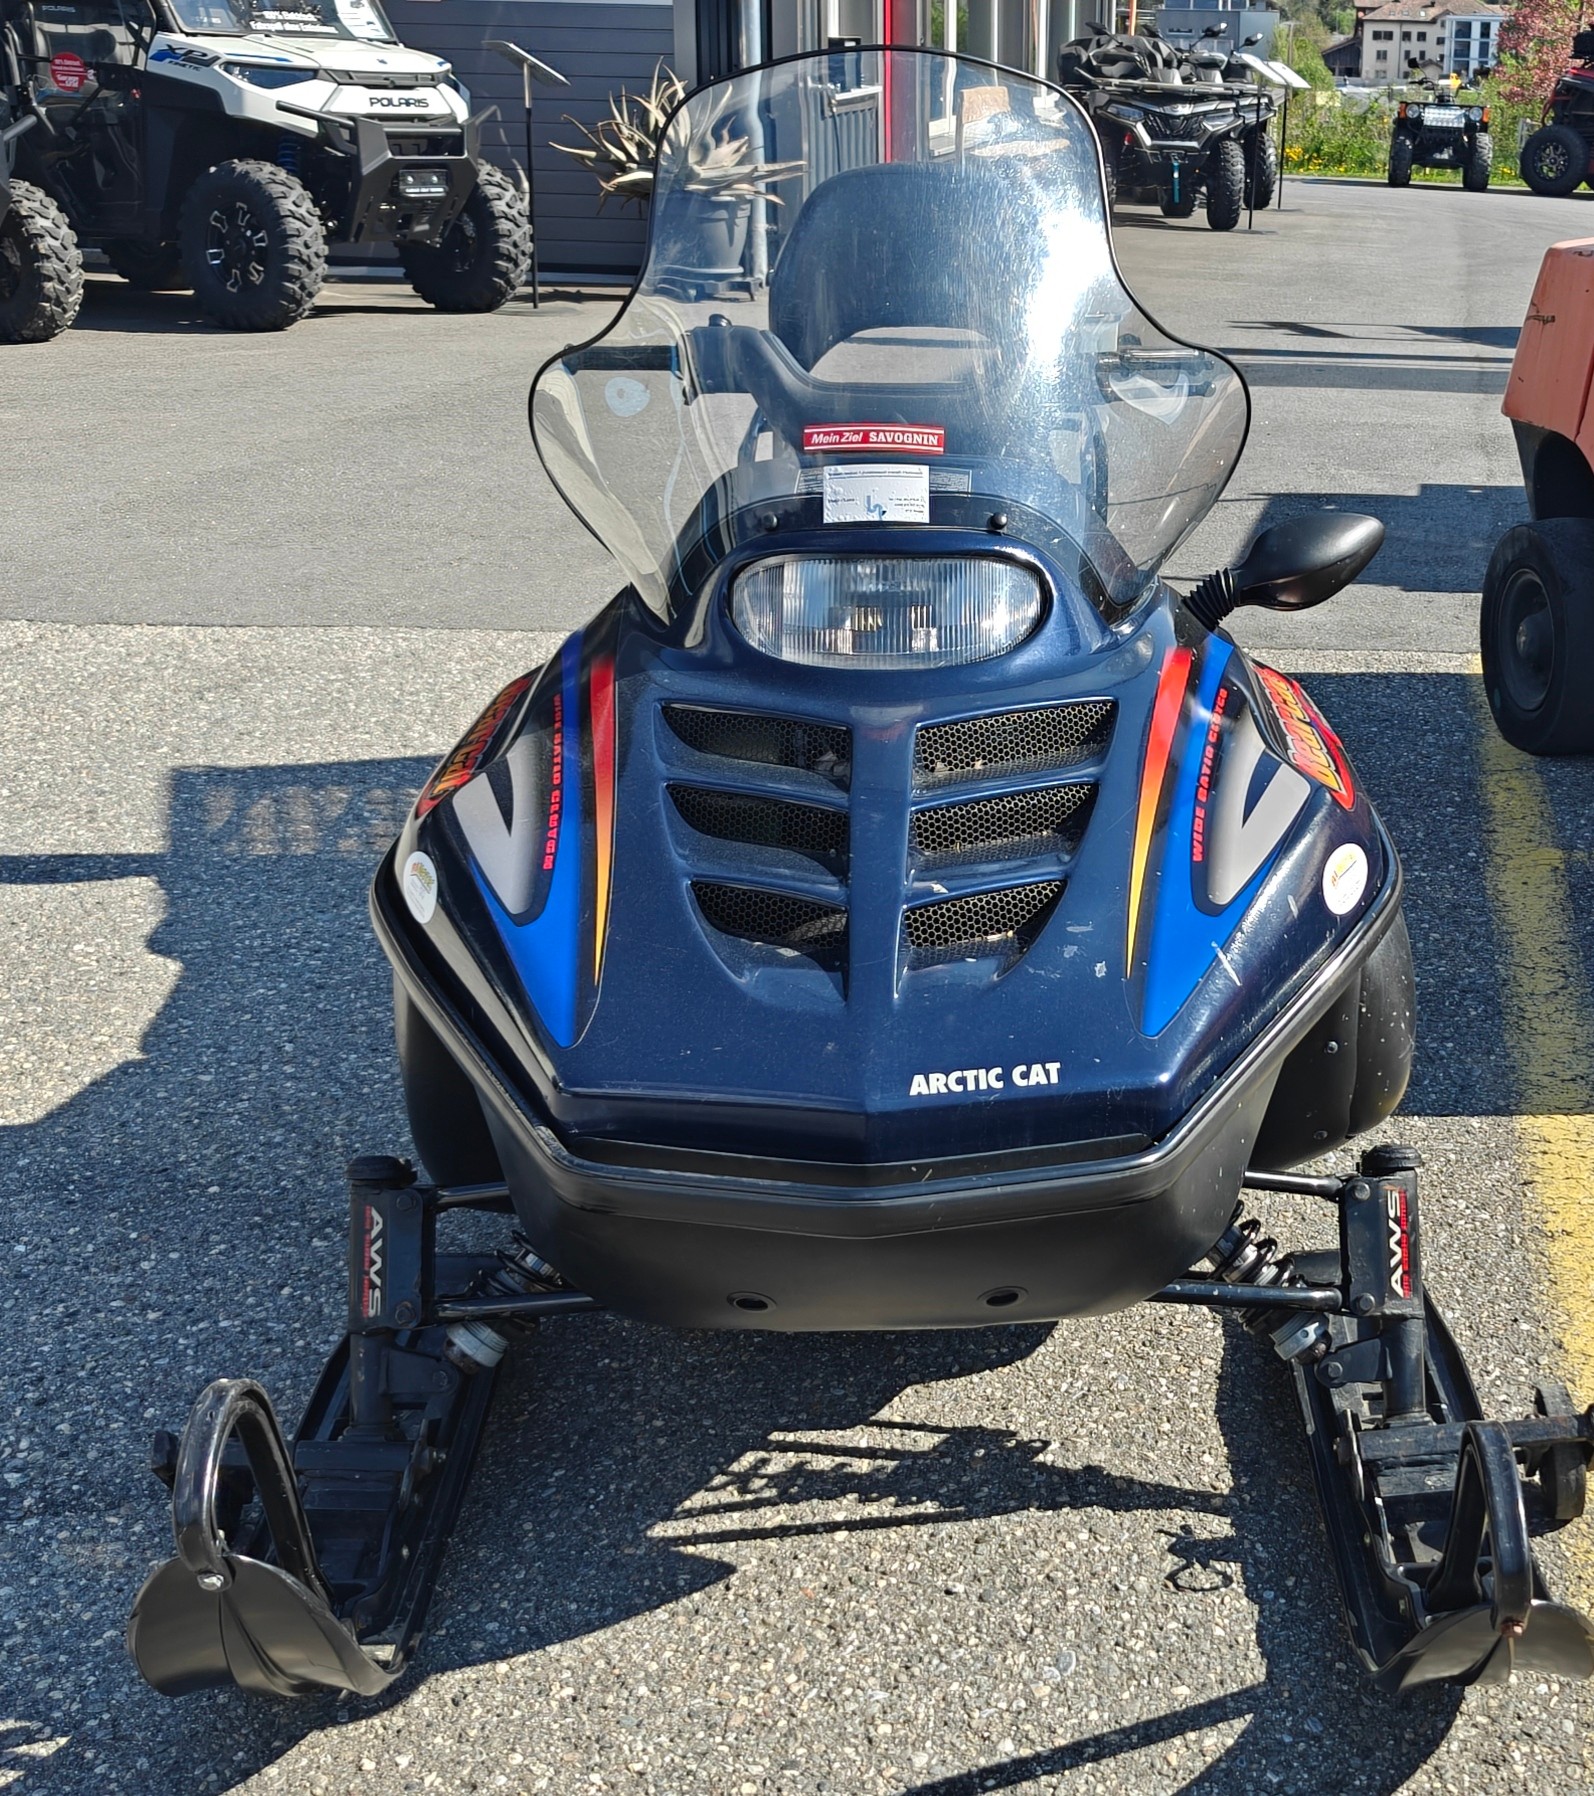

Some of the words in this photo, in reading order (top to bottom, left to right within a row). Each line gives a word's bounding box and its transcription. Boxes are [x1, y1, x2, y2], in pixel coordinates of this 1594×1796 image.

[167, 60, 202, 72] KINETIC
[369, 97, 430, 108] POLARIS
[811, 433, 840, 444] Mein
[840, 432, 864, 443] Ziel
[868, 431, 939, 446] SAVOGNIN
[552, 732, 562, 785] RATIO
[1197, 745, 1215, 803] RATIO
[1192, 806, 1206, 862] WIDE
[909, 1067, 1005, 1096] ARCTIC
[1011, 1062, 1061, 1087] CAT
[370, 1206, 383, 1318] AWS
[1387, 1190, 1404, 1298] AWS
